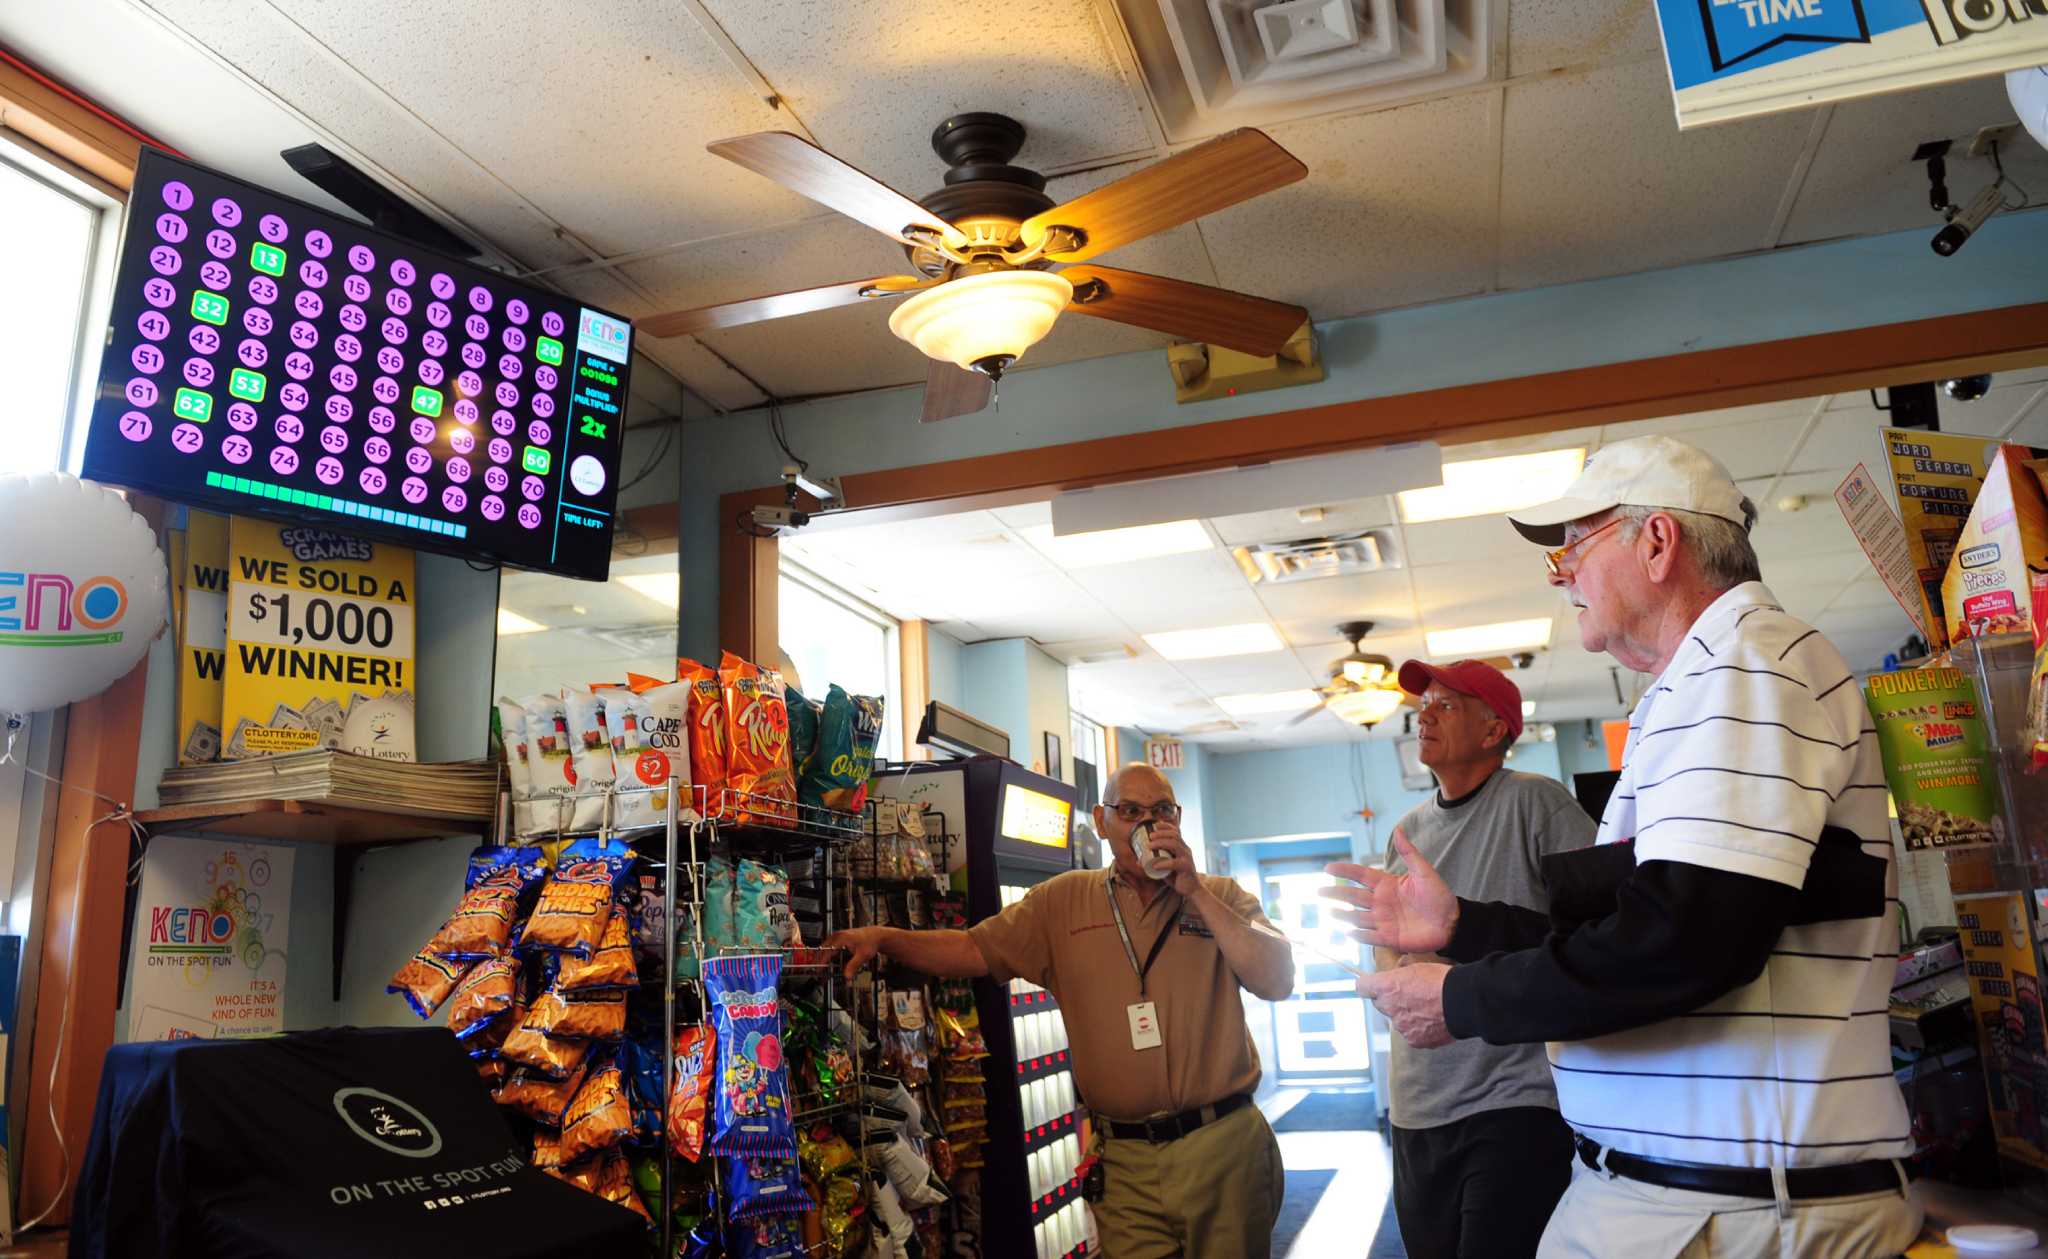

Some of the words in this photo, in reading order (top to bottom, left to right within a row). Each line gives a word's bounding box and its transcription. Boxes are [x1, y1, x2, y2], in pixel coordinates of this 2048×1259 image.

[1738, 0, 1823, 28] TIME
[174, 189, 182, 204] 1
[220, 205, 234, 220] 2
[268, 221, 280, 236] 3
[312, 238, 324, 251] 4
[357, 252, 368, 266] 5
[398, 267, 408, 280] 6
[438, 281, 448, 292] 7
[476, 292, 486, 305] 8
[513, 305, 523, 318] 9
[544, 317, 561, 331] 10
[164, 219, 180, 236] 11
[212, 235, 231, 252] 12
[260, 250, 278, 267] 13
[304, 265, 324, 282] 14
[349, 280, 365, 295] 15
[391, 293, 407, 309] 16
[432, 307, 449, 321] 17
[469, 320, 486, 334] 18
[507, 332, 522, 346] 19
[539, 343, 560, 357] 20
[154, 252, 176, 268] 21
[203, 269, 228, 285] 22
[251, 282, 274, 299] 23
[299, 294, 319, 310] 24
[342, 310, 363, 326] 25
[384, 322, 405, 338] 26
[426, 335, 445, 350] 27
[465, 350, 483, 362] 28
[502, 359, 520, 374] 29
[538, 371, 558, 385] 30
[582, 315, 626, 344] KENO
[150, 284, 170, 301] 31
[197, 298, 221, 313] 32
[247, 314, 270, 330] 33
[293, 327, 316, 341] 34
[338, 339, 358, 355] 35
[380, 352, 400, 368] 36
[422, 364, 441, 380] 37
[460, 376, 479, 389] 38
[498, 388, 517, 401] 39
[533, 398, 552, 412] 40
[142, 318, 164, 334] 41
[192, 330, 218, 346] 42
[240, 345, 265, 359] 43
[287, 359, 311, 374] 44
[332, 372, 354, 386] 45
[375, 383, 396, 398] 46
[414, 396, 437, 409] 47
[456, 406, 476, 419] 48
[493, 417, 513, 429] 49
[530, 426, 550, 440] 50
[138, 350, 158, 367] 51
[188, 363, 212, 381] 52
[237, 376, 259, 393] 53
[283, 388, 306, 405] 54
[326, 401, 350, 417] 55
[372, 412, 392, 428] 56
[414, 423, 433, 437] 57
[488, 443, 510, 458] 59
[527, 453, 547, 467] 60
[131, 384, 153, 400] 61
[180, 396, 205, 414] 62
[230, 409, 253, 425] 63
[276, 420, 300, 436] 64
[321, 432, 344, 447] 65
[366, 442, 388, 457] 66
[409, 453, 430, 466] 67
[449, 462, 468, 477] 68
[484, 472, 506, 486] 69
[524, 480, 544, 494] 70
[1893, 443, 1929, 457] WORD
[126, 418, 146, 435] 71
[176, 429, 199, 446] 72
[226, 441, 248, 457] 73
[274, 452, 295, 468] 74
[316, 463, 339, 479] 75
[363, 472, 382, 488] 76
[406, 483, 425, 498] 77
[446, 492, 464, 507] 78
[484, 500, 502, 514] 79
[520, 509, 540, 524] 80
[1916, 460, 1971, 475] SEARCH
[1901, 485, 1967, 501] FORTUNE
[564, 512, 582, 525] TIME
[294, 542, 371, 560] GAMES
[239, 556, 289, 585] WE
[299, 566, 378, 598] SOLD
[387, 580, 407, 602] A
[249, 592, 393, 649] $1,000
[239, 644, 402, 688] WINNER!
[1870, 669, 1940, 698] POWER
[244, 727, 318, 742] CTLOTTERY.ORG
[641, 716, 681, 733] CAPE
[370, 747, 410, 760] Lottery
[650, 732, 680, 749] COD
[1152, 743, 1181, 768] EXIT
[151, 907, 234, 944] KENO
[148, 956, 163, 967] ON
[167, 956, 184, 967] THE
[187, 956, 211, 967] SPOT
[215, 995, 252, 1006] WHOLE
[254, 994, 276, 1004] NEW
[249, 981, 267, 991] IT'S
[269, 981, 277, 991] A
[212, 1009, 236, 1020] KIND
[239, 1008, 253, 1019] OF
[727, 1001, 778, 1020] CANDY
[330, 1183, 374, 1205] ON
[376, 1176, 431, 1197] THE
[432, 1166, 492, 1188] SPOT
